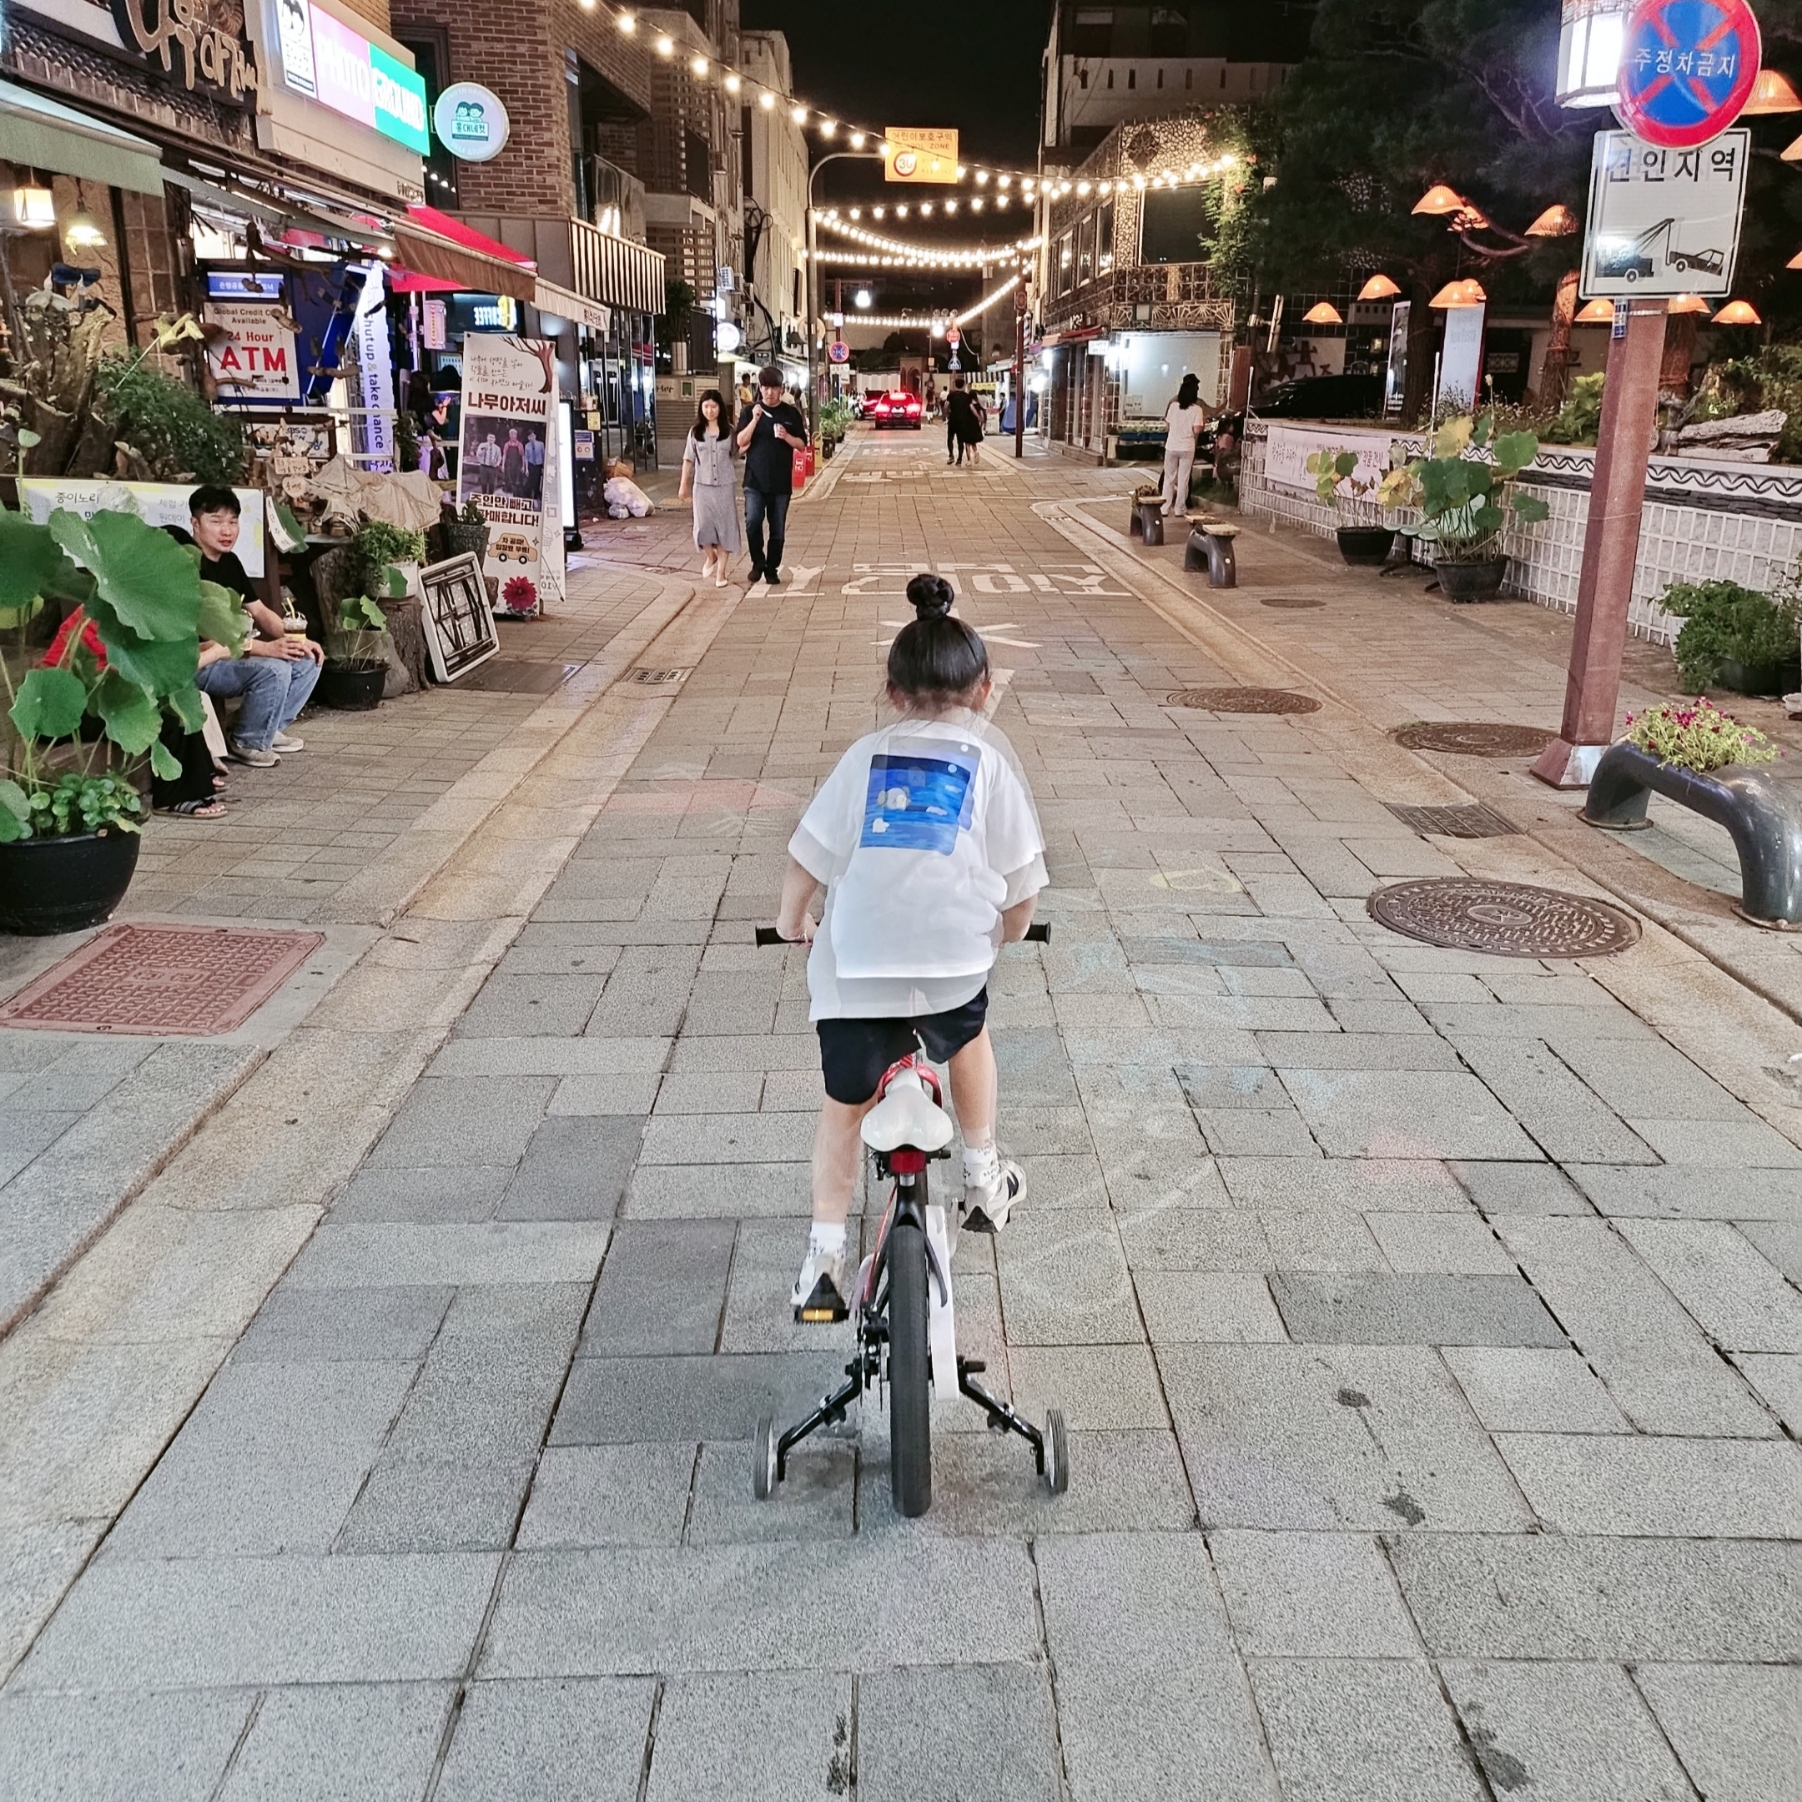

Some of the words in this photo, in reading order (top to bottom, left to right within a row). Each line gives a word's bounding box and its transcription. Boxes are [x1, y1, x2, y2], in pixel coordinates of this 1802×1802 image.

[1634, 48, 1735, 78] 주정차금지
[455, 122, 486, 134] 홍대네컷
[892, 131, 953, 141] 어린이보호구역
[1607, 147, 1736, 182] 견인지역
[214, 308, 238, 316] Global
[240, 308, 263, 316] Credit
[227, 331, 241, 341] 24
[246, 331, 274, 342] Hour
[363, 313, 375, 343] hut
[220, 346, 287, 372] ATM
[368, 374, 382, 403] take
[467, 391, 547, 416] 나무아저씨
[55, 491, 100, 504] 종이노리
[471, 493, 506, 508] 주인만
[509, 498, 533, 512] 빼고
[159, 513, 186, 524] 원데이
